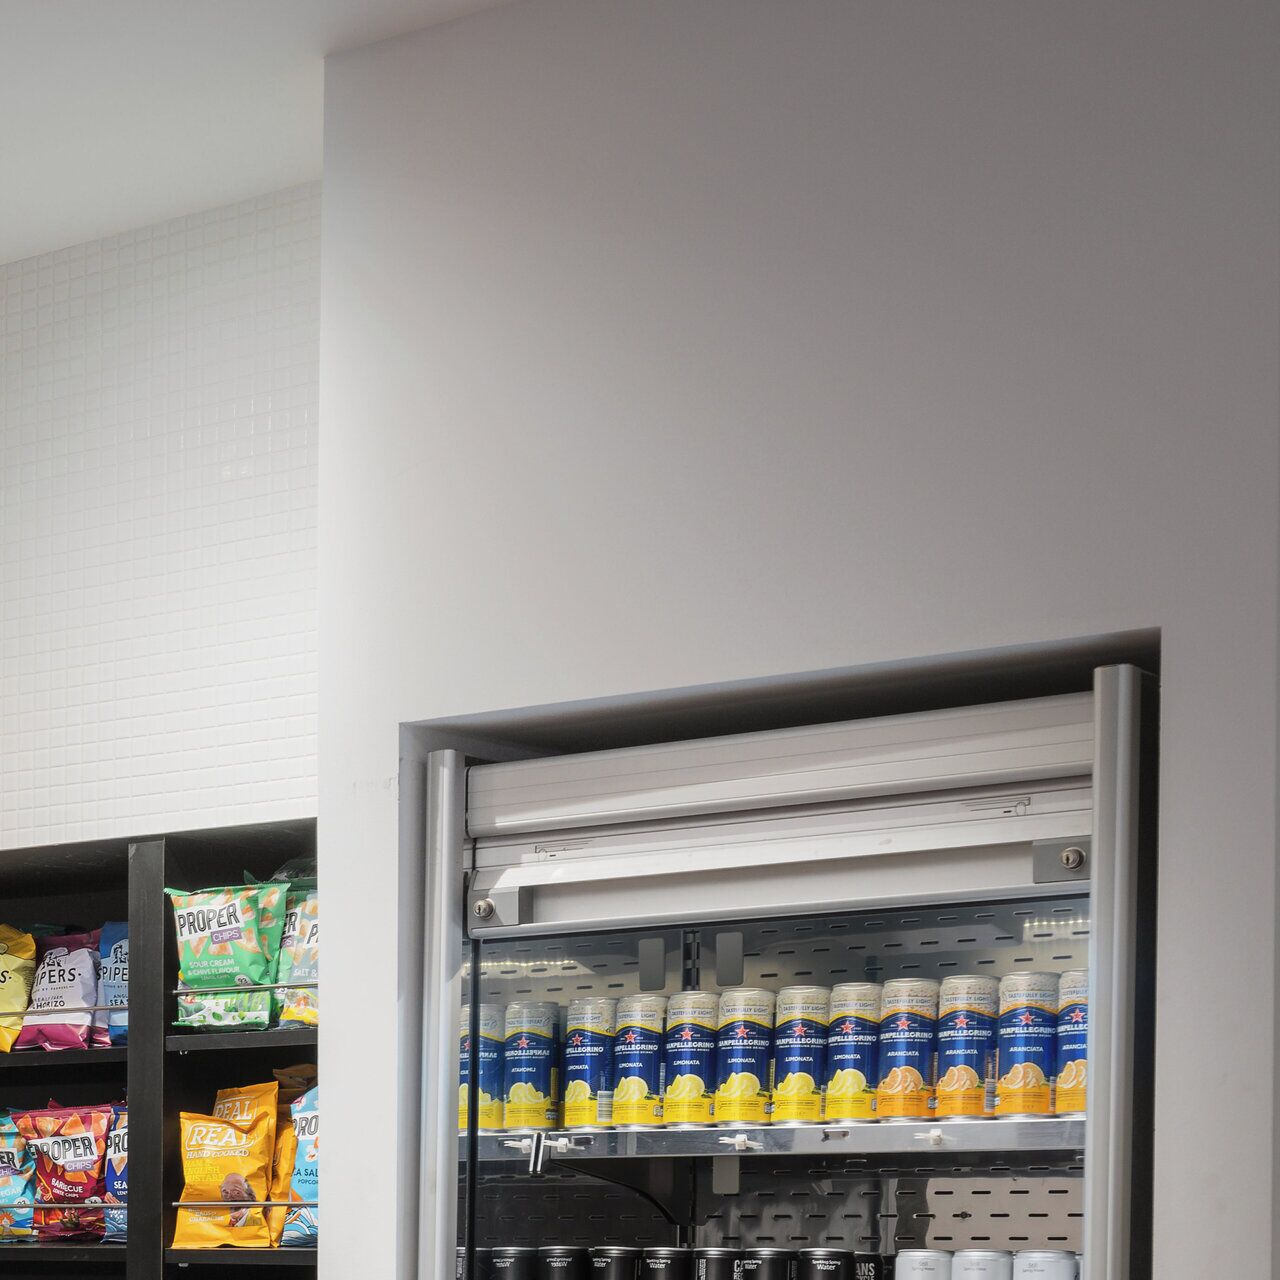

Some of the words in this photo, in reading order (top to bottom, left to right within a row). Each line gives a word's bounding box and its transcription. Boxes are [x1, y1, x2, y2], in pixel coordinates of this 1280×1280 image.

[178, 902, 240, 937] PROPER
[213, 930, 239, 941] CHIPS
[100, 967, 128, 981] PIPE
[293, 969, 309, 977] SALT
[34, 968, 77, 987] IPERS
[938, 1030, 992, 1038] SANPELLEGRINO
[1000, 1026, 1056, 1035] SANPELLEGRINO
[880, 1031, 933, 1039] SANPELLEGRINO
[666, 1041, 715, 1049] SANPELLEGRINO
[719, 1039, 770, 1047] SANPELLEGRINO
[777, 1037, 827, 1045] SANPELLEGRINO
[190, 1126, 254, 1146] REAL
[66, 1162, 91, 1170] CHIPS
[51, 1178, 83, 1193] BARBECUE
[114, 1181, 127, 1189] SEA
[856, 1263, 875, 1275] ANS
